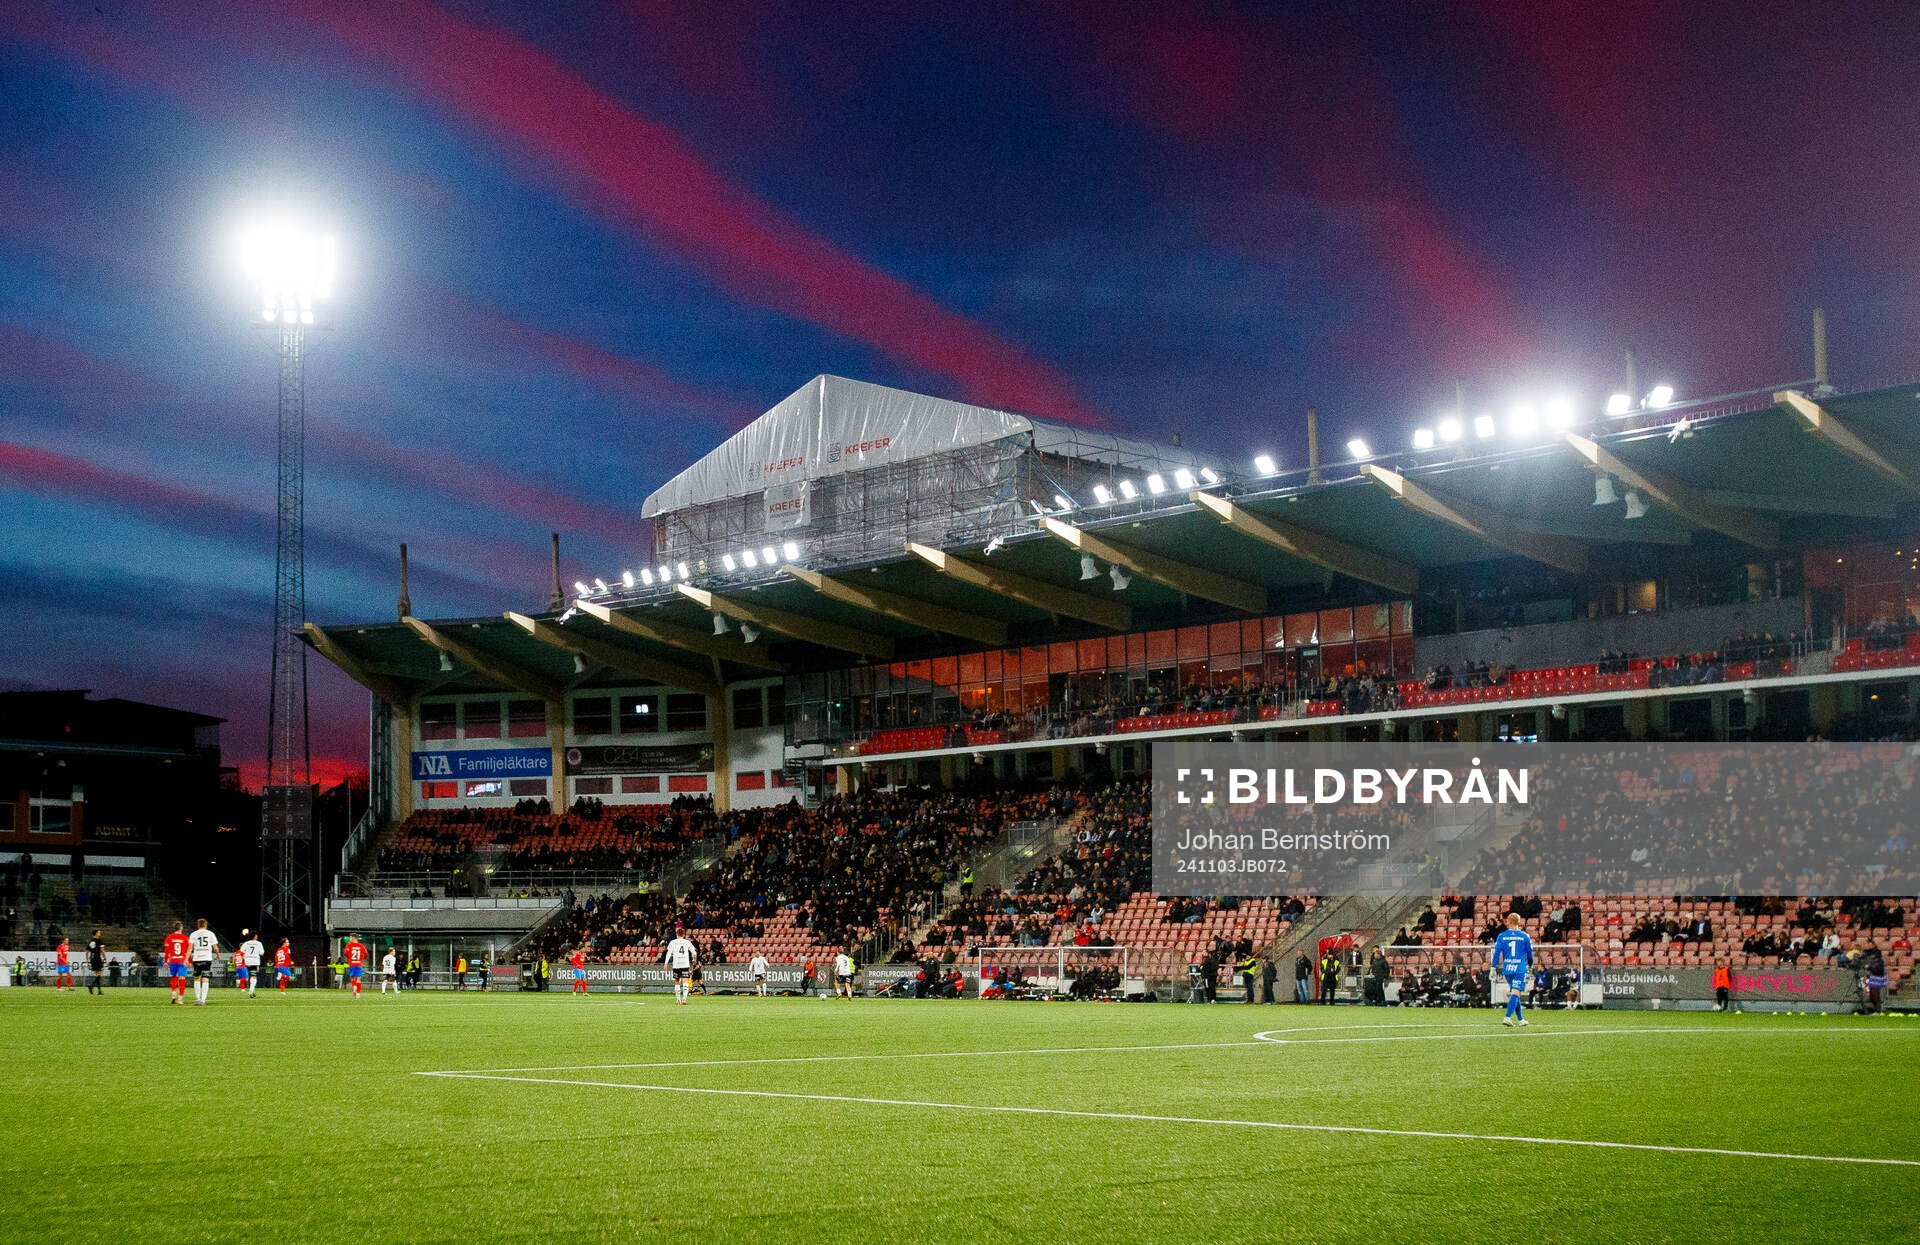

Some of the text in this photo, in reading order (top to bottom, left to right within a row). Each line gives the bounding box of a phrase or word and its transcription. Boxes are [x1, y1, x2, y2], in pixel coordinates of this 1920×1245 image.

[845, 437, 890, 455] KAEFER
[418, 755, 548, 776] NA Familjeläktare
[197, 936, 209, 947] 15
[173, 942, 182, 955] 9
[249, 946, 255, 955] 7
[679, 945, 685, 955] 4
[1508, 941, 1516, 957] 1
[351, 949, 361, 961] 21
[843, 959, 848, 967] 3
[588, 969, 636, 981] SPORTKLUBB
[715, 970, 721, 982] &
[723, 970, 756, 982] PASSIO
